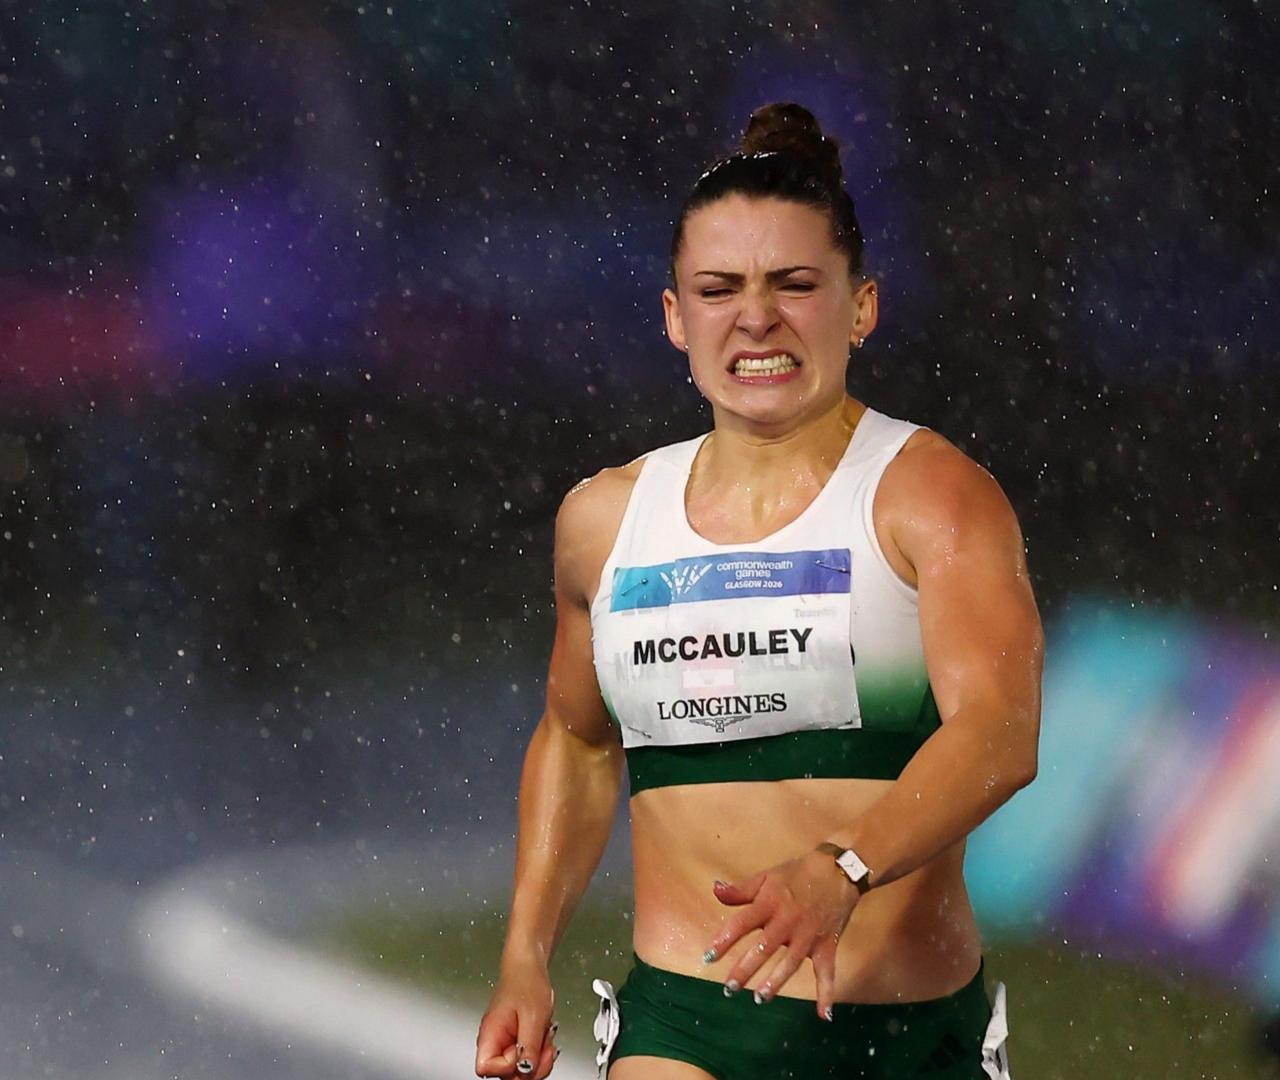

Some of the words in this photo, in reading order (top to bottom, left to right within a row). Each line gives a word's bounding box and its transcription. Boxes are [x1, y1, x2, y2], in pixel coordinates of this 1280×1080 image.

[717, 560, 793, 571] commonwealth
[736, 569, 771, 580] games
[725, 580, 761, 590] GLASGOW
[762, 580, 783, 588] 2026
[633, 628, 814, 666] MCCAULEY
[657, 693, 788, 720] LONGINES
